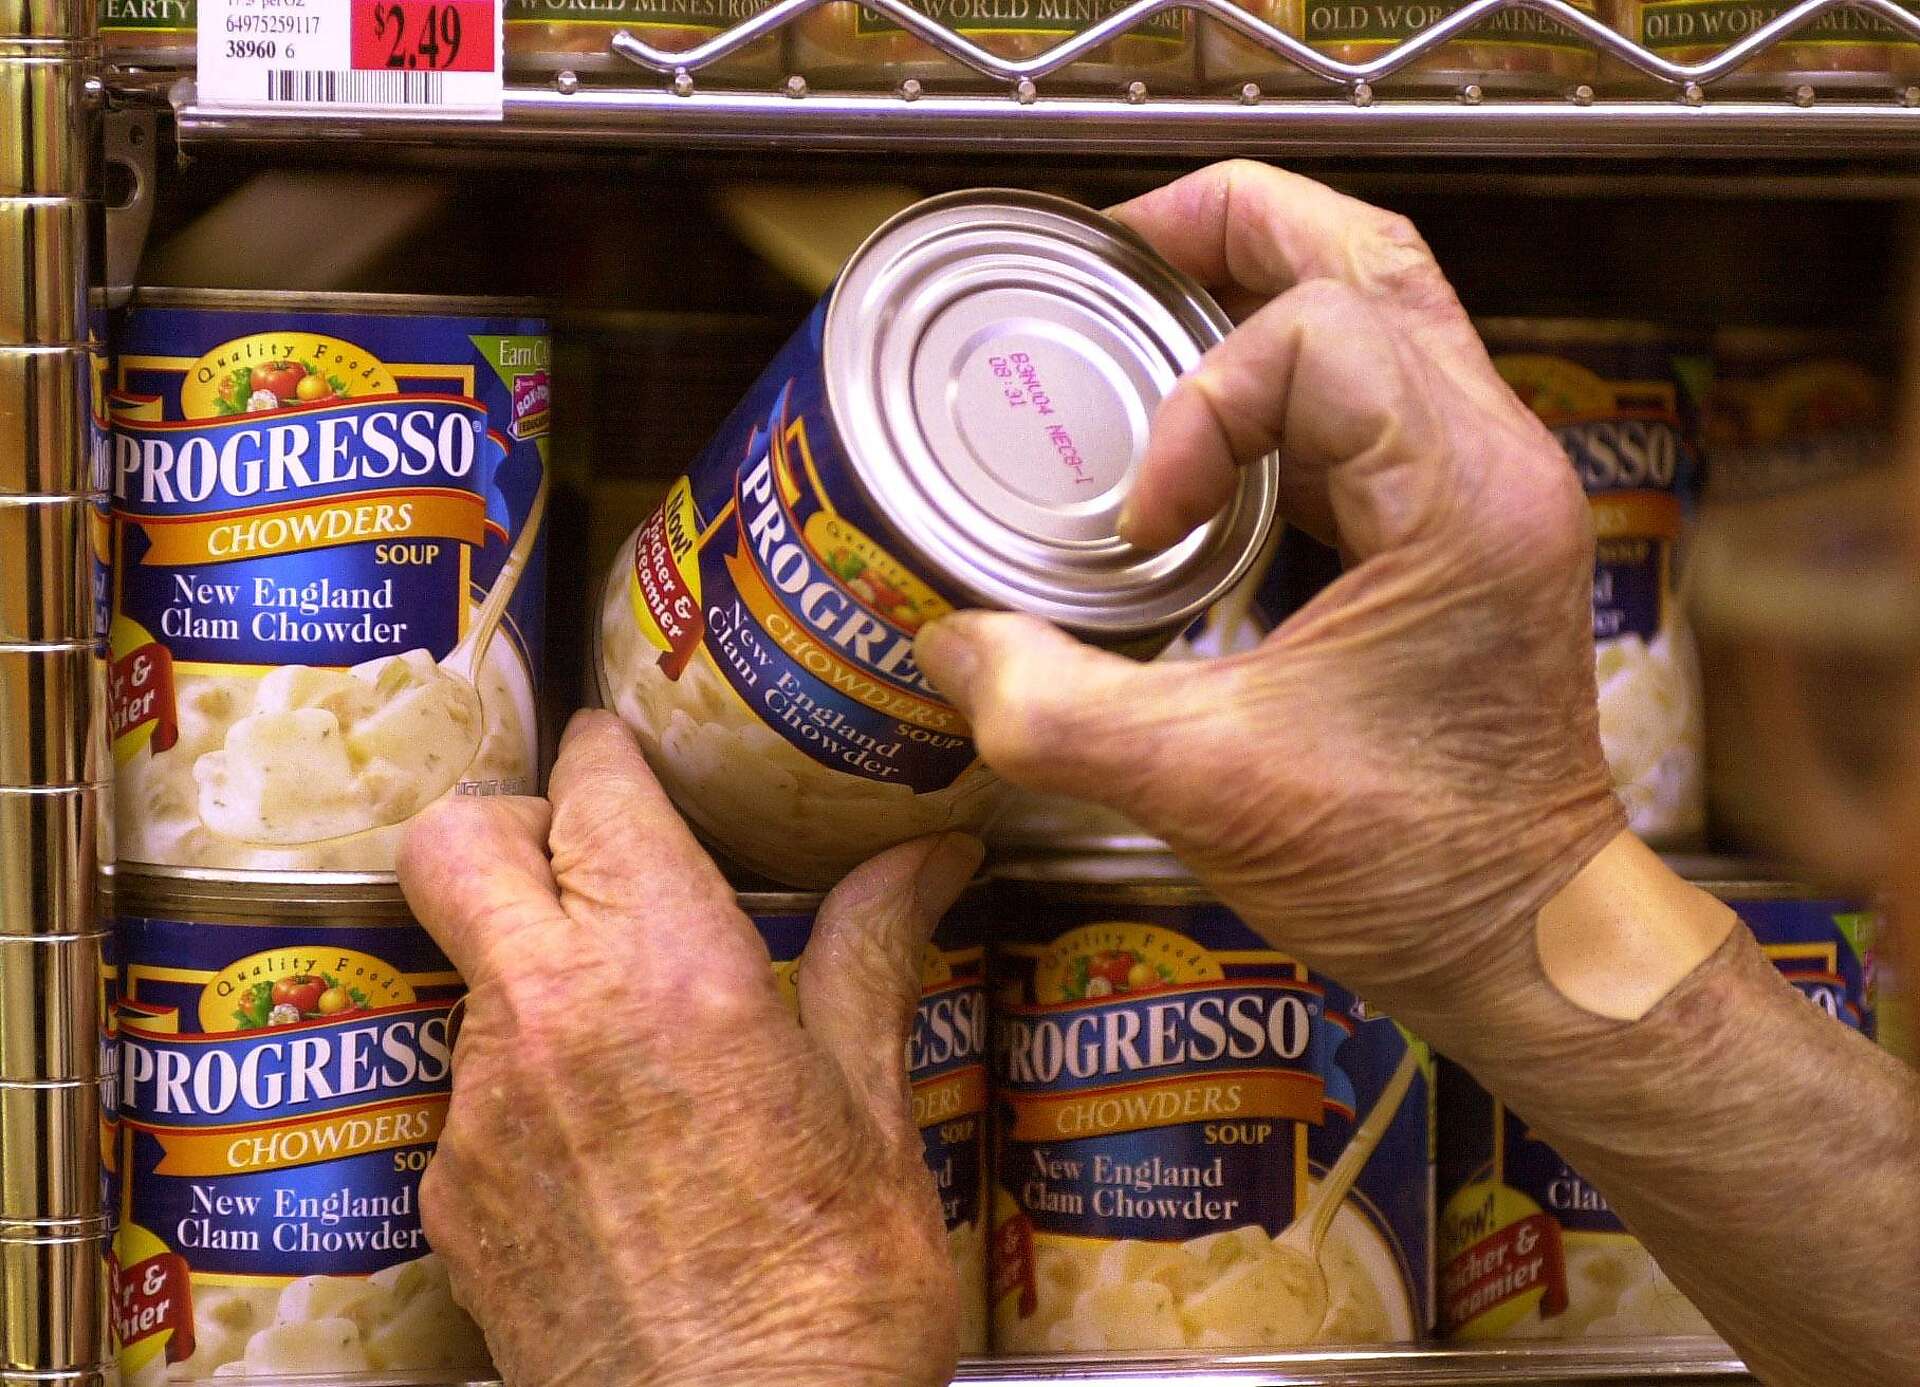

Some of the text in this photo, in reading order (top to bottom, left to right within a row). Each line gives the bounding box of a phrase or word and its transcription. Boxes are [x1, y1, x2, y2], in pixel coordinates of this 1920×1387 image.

[107, 0, 191, 18] EARTY
[226, 15, 320, 34] 64975259117
[1311, 7, 1369, 30] OLD
[1376, 6, 1460, 29] WOR
[1646, 8, 1777, 39] OLD WOR
[226, 40, 295, 59] 38960 6
[374, 4, 462, 68] $2.49
[198, 342, 382, 390] Quality Foods
[115, 411, 476, 505] PROGRESSO
[207, 503, 414, 557] CHOWDERS
[667, 488, 694, 564] Now!
[375, 544, 440, 566] SOUP
[741, 456, 925, 688] PROGRE
[172, 574, 394, 616] New England
[637, 526, 684, 638] Creamier
[161, 608, 408, 644] Clam Chowder
[708, 606, 900, 777] Clam Chowder
[726, 599, 902, 758] New England
[765, 613, 956, 728] CHOWDERS
[895, 723, 965, 749] SOUP
[217, 956, 401, 1000] Quality Foods
[1009, 996, 1311, 1085] ROGRESSO
[124, 1017, 450, 1115] PROGRESS
[1056, 1085, 1243, 1135] CHOWDERS
[227, 1111, 430, 1169] CHOWDERS
[1204, 1124, 1273, 1147] SOUP
[394, 1151, 433, 1172] SO
[1033, 1149, 1225, 1193] New England
[190, 1185, 411, 1225] New England
[1022, 1181, 1240, 1222] Clam Chowder
[1550, 1178, 1608, 1211] Cla
[176, 1218, 424, 1253] Clam Chowder
